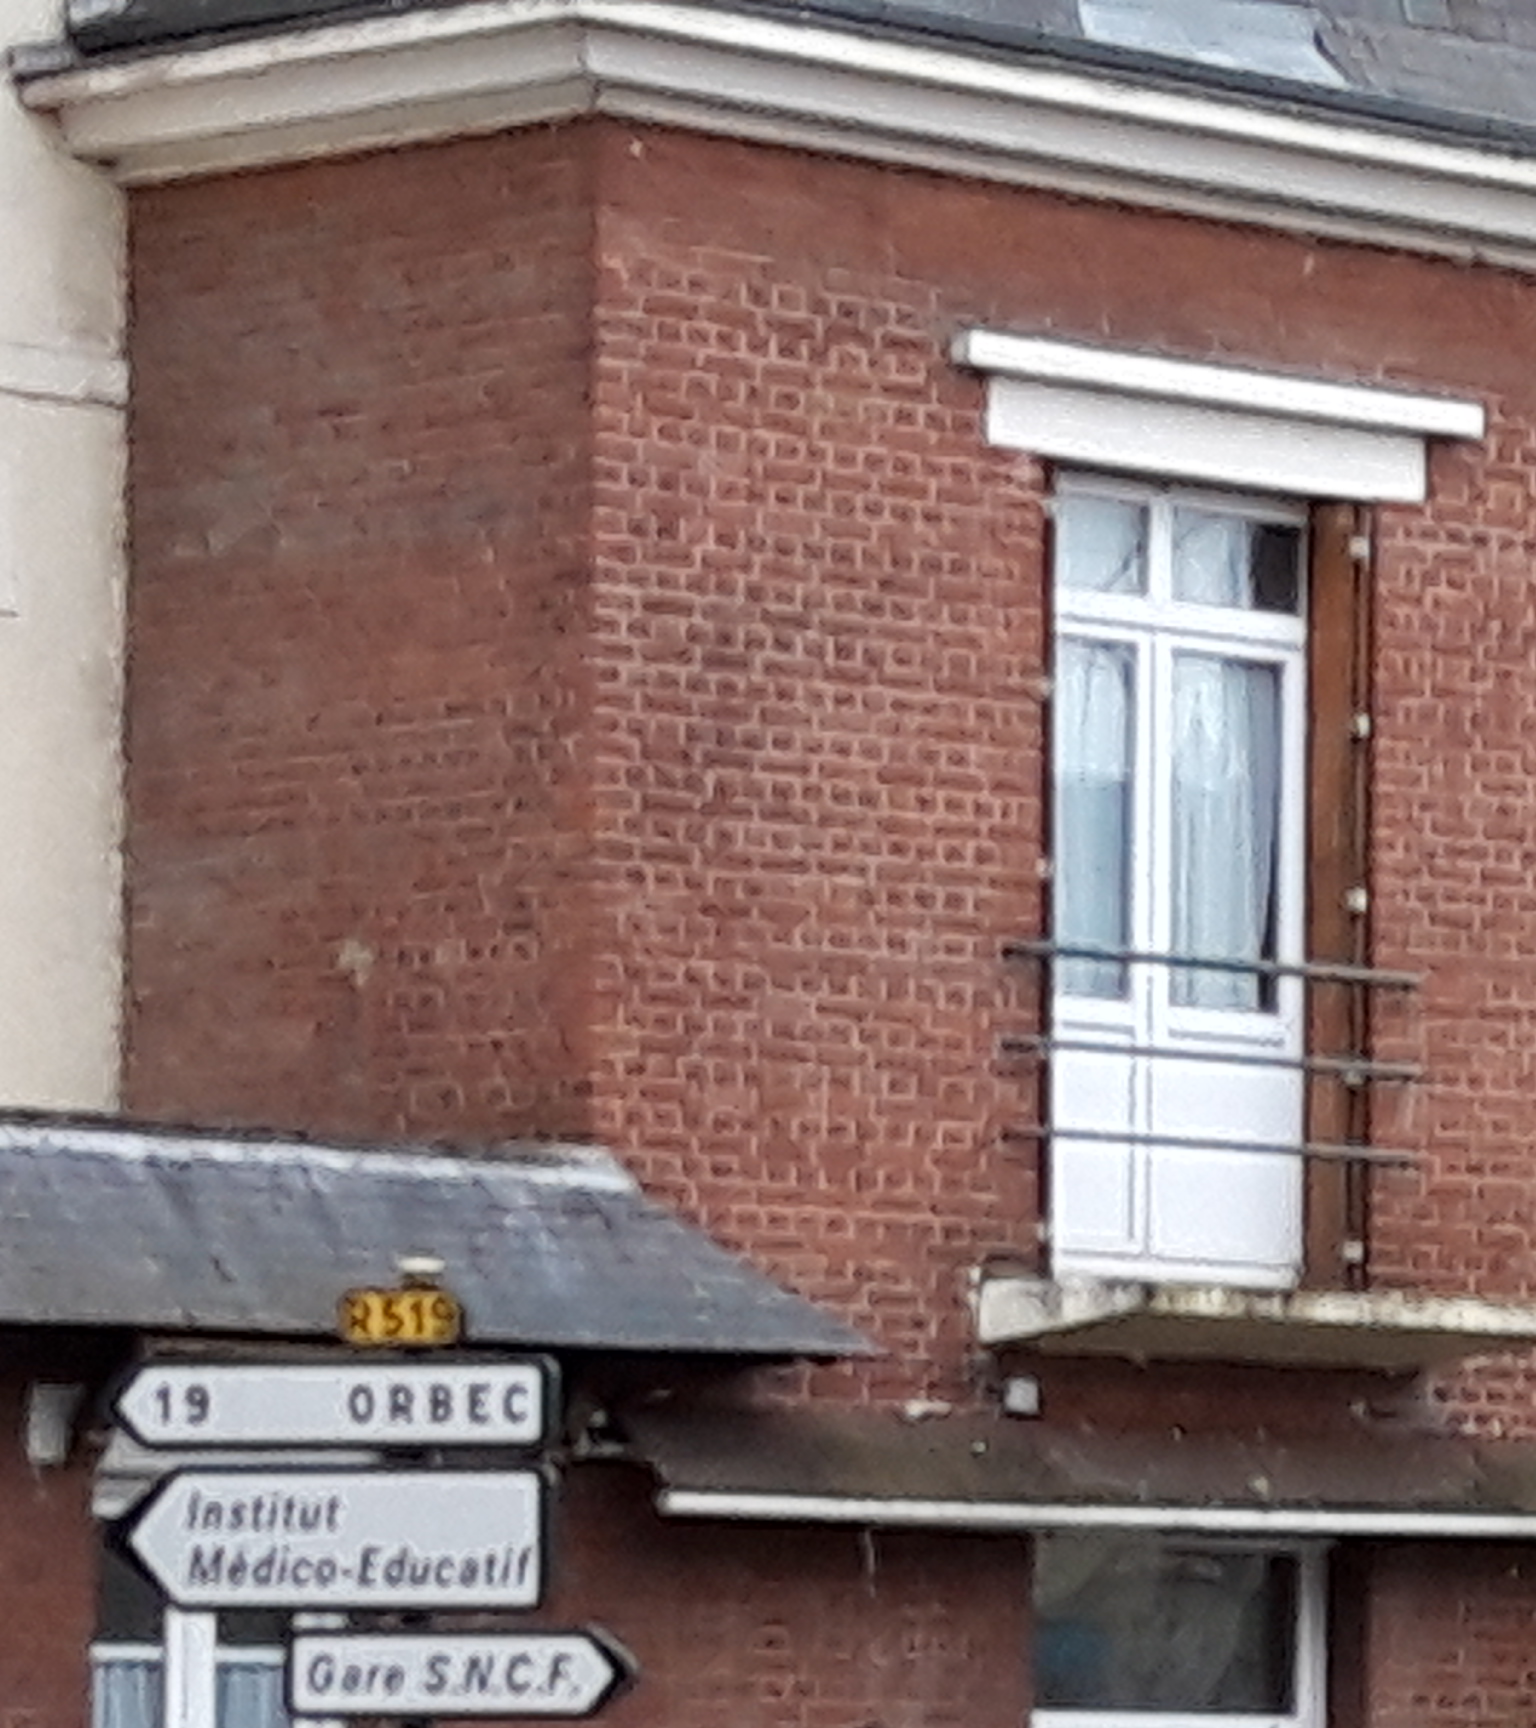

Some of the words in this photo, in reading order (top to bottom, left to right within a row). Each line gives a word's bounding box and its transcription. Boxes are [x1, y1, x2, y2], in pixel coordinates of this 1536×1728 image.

[155, 1385, 208, 1423] 19
[347, 1384, 529, 1424] ORBEC
[184, 1490, 342, 1531] Institut
[307, 1653, 405, 1696] Gare
